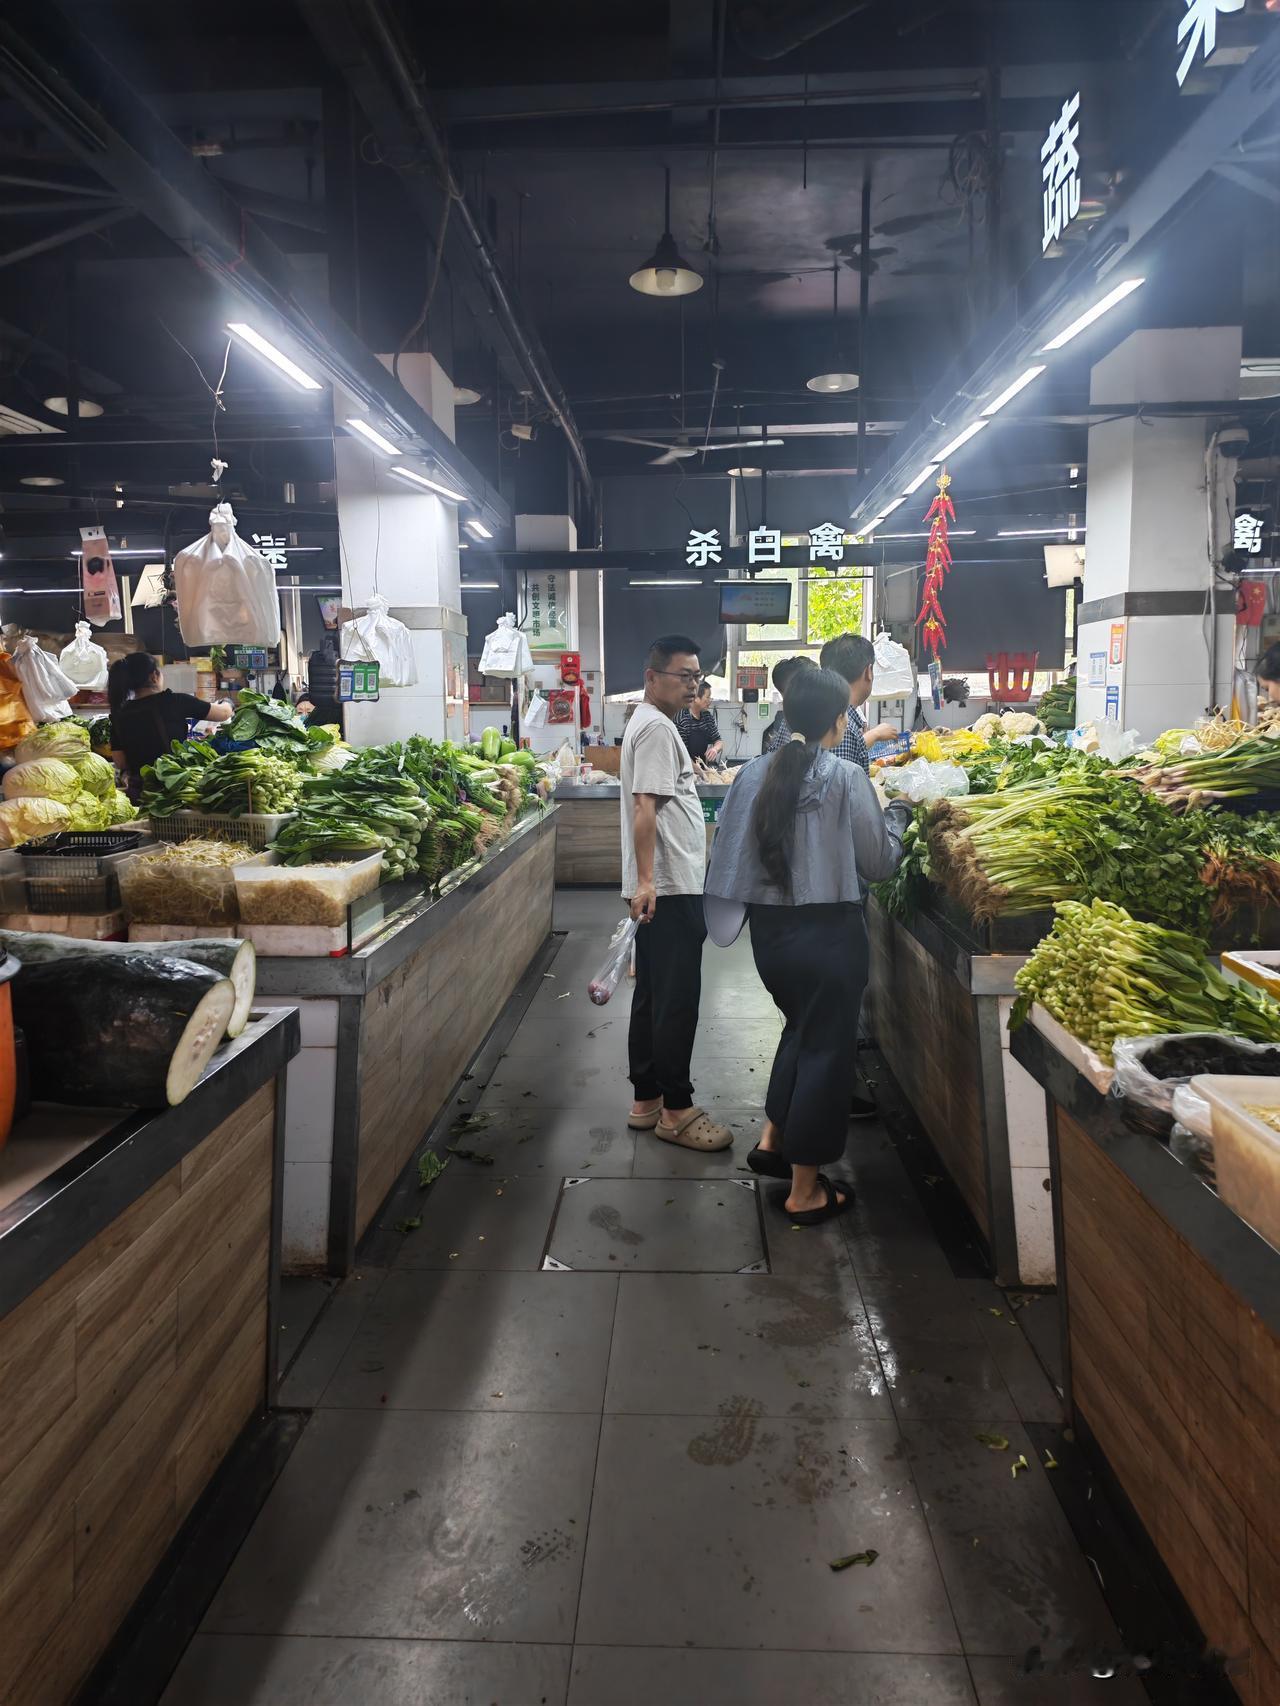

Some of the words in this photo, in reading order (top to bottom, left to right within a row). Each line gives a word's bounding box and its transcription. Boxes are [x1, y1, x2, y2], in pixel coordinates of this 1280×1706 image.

[685, 522, 846, 567] 杀白禽
[531, 583, 541, 637] 共创文明市场
